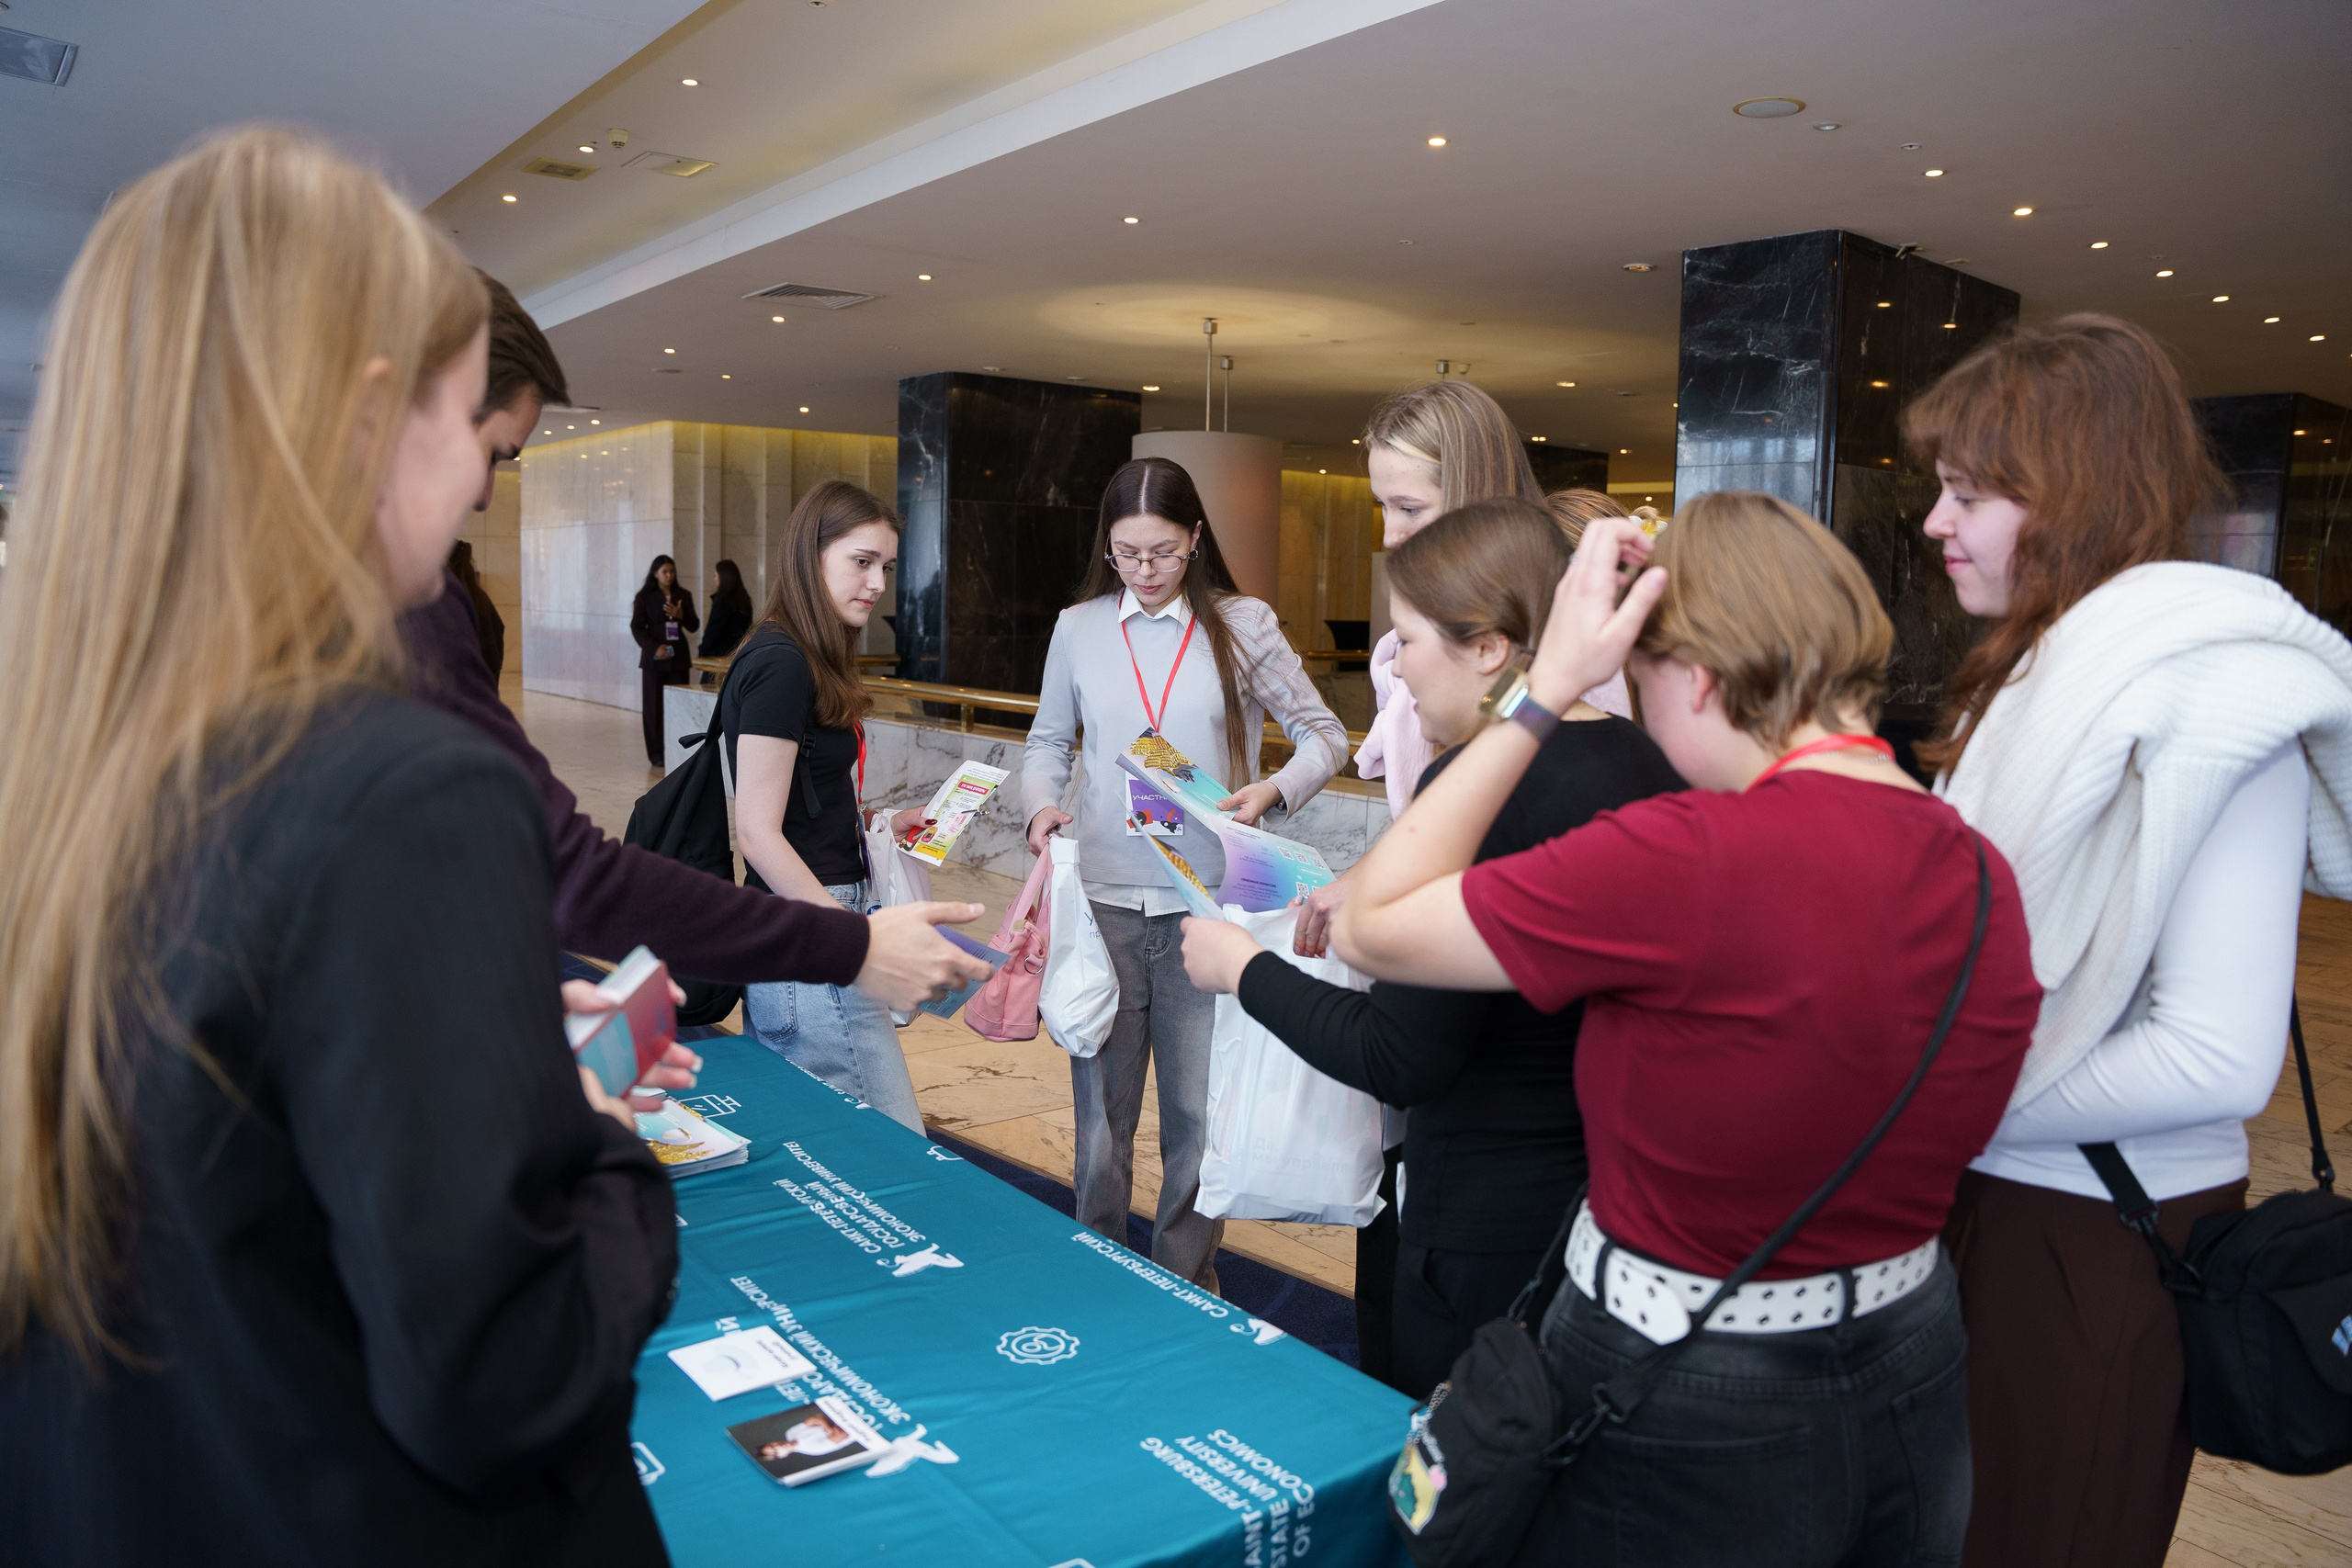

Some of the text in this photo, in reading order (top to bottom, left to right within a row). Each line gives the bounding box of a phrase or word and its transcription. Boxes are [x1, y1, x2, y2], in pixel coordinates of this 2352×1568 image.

[1070, 1232, 1228, 1318] САНКТ-ПЕТЕРБУРГСКИЙ
[1139, 1437, 1263, 1568] AINT-PETERSBURG
[1174, 1436, 1278, 1501] UNIVERSITY
[1207, 1429, 1316, 1519] ECONOMICS
